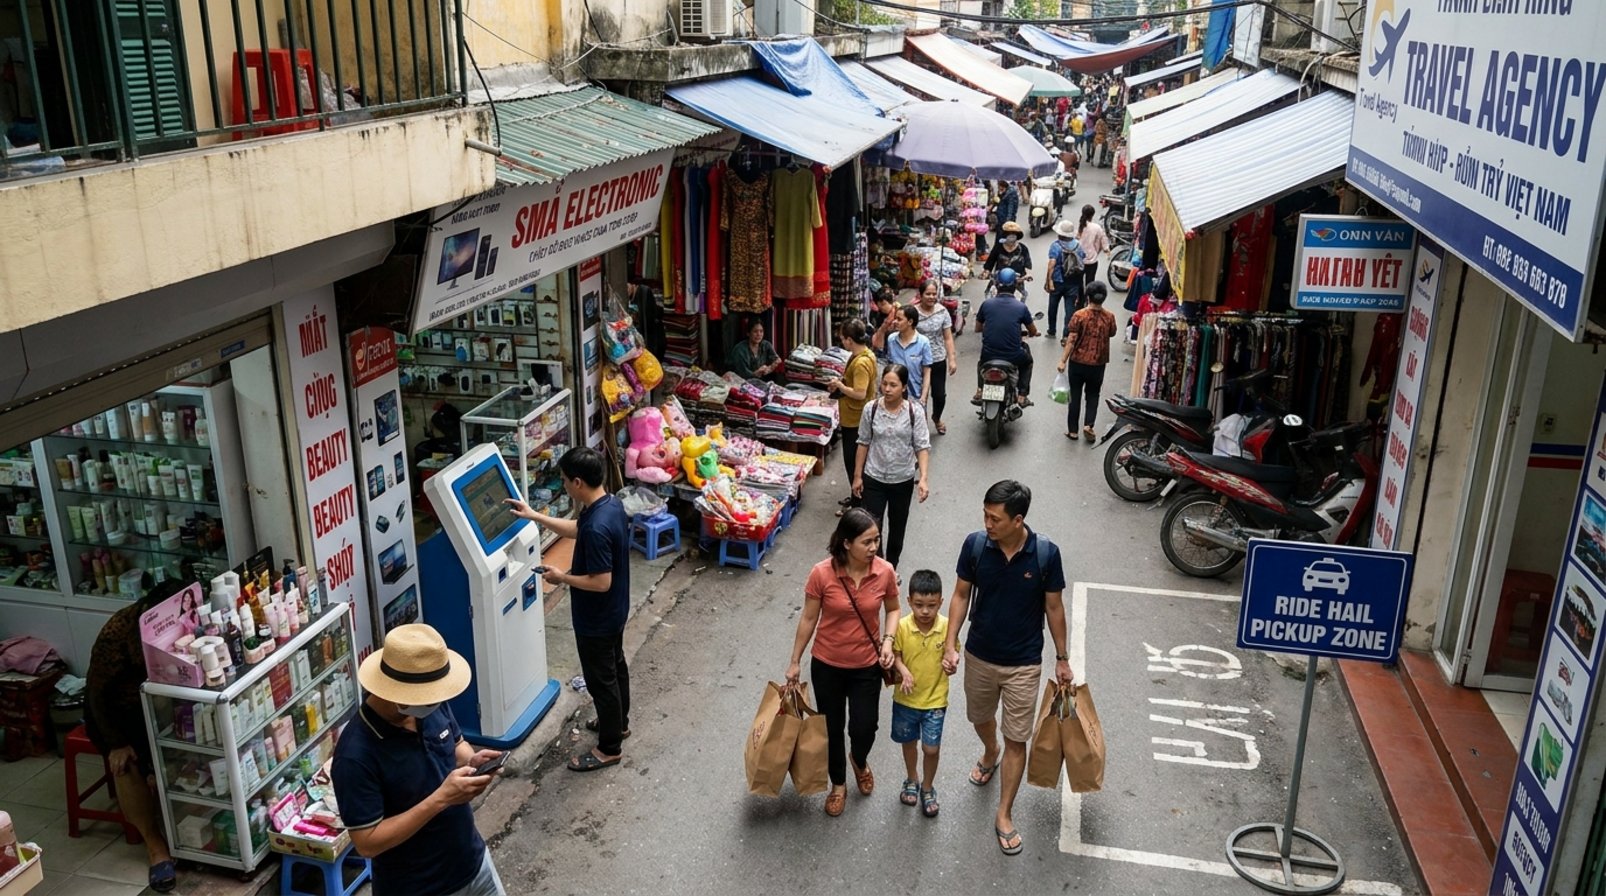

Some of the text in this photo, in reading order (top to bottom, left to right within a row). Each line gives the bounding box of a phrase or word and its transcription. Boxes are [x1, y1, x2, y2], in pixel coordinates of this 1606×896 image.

[1403, 41, 1606, 163] TRAVEL AGENCY
[563, 164, 664, 231] ELECTRONIC
[1533, 186, 1572, 236] NAM
[306, 428, 349, 481] BEAUTY
[313, 484, 354, 539] BEAUTY
[1250, 618, 1388, 651] PICKUP ZONE
[1274, 595, 1374, 624] RIDE HAIL
